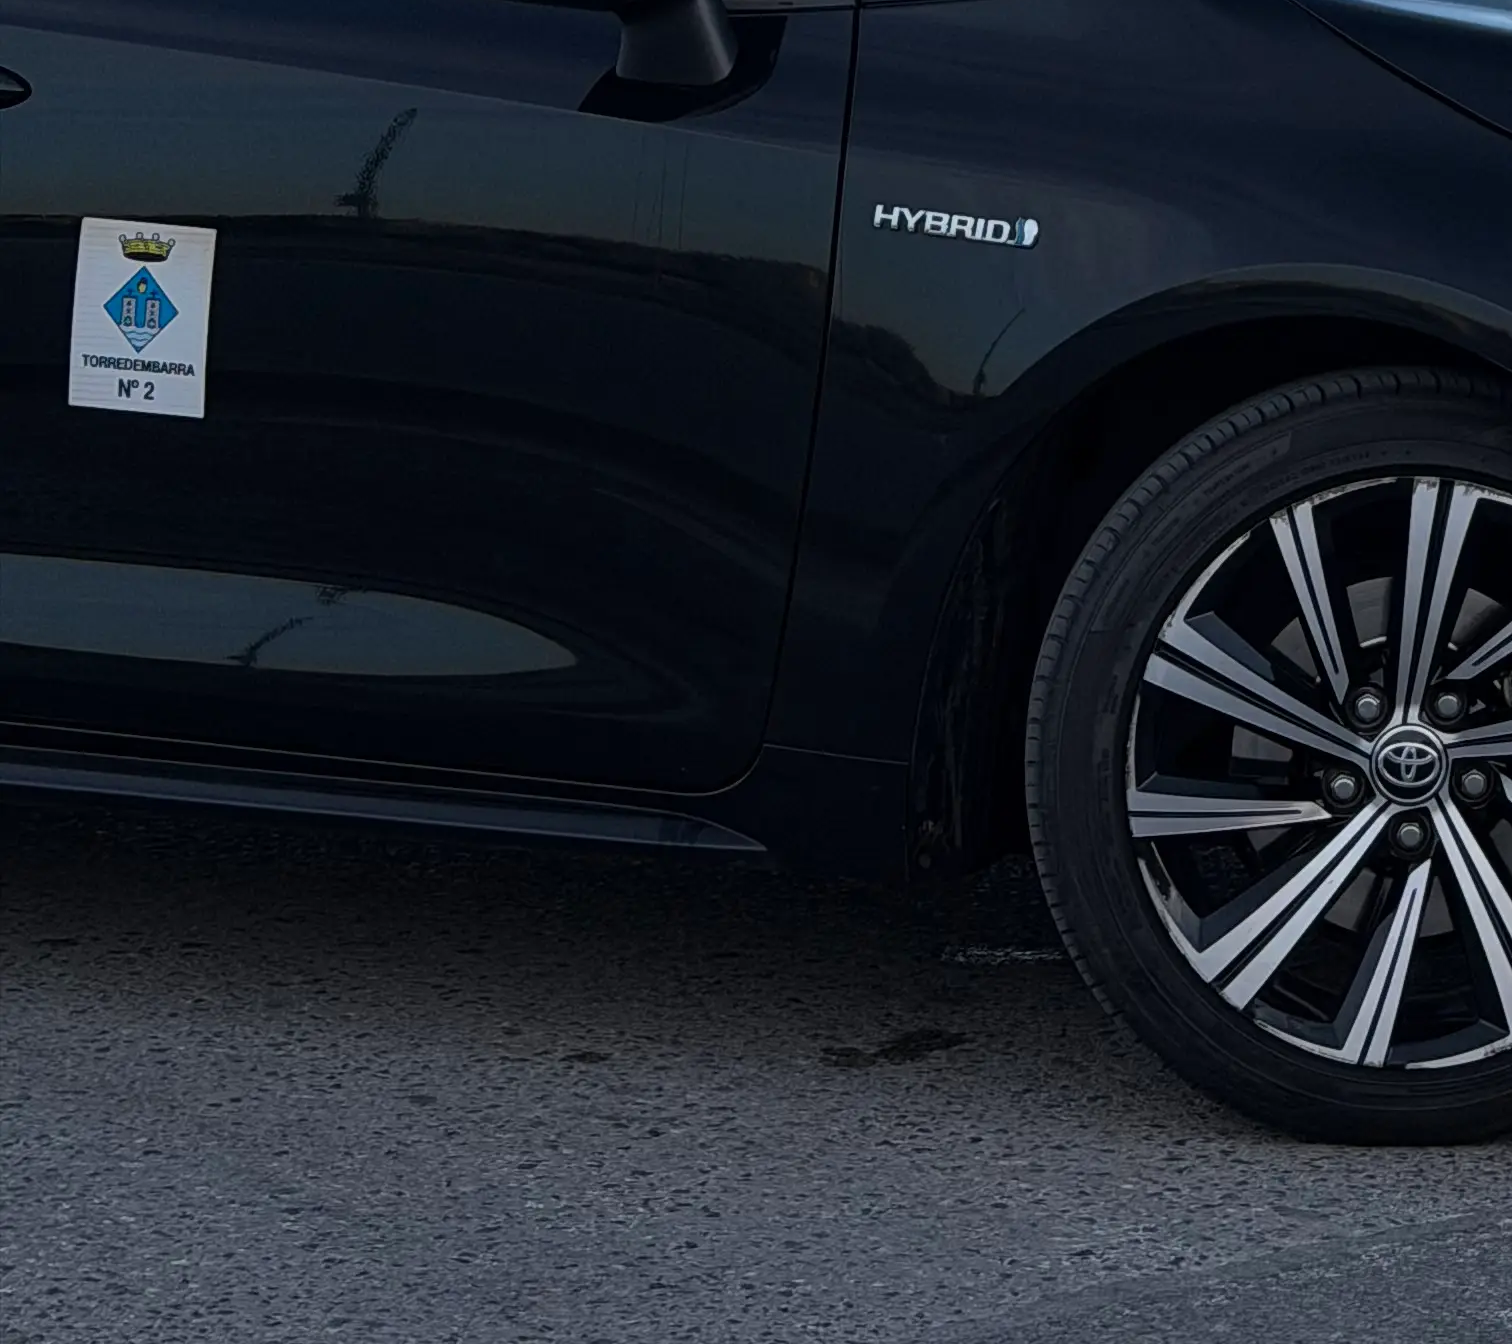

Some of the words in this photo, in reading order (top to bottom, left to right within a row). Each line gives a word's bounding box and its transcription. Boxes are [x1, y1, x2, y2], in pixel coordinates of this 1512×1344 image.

[873, 204, 1012, 244] HYBRID
[82, 354, 195, 377] TORREDEMBARRA
[143, 381, 155, 401] 2
